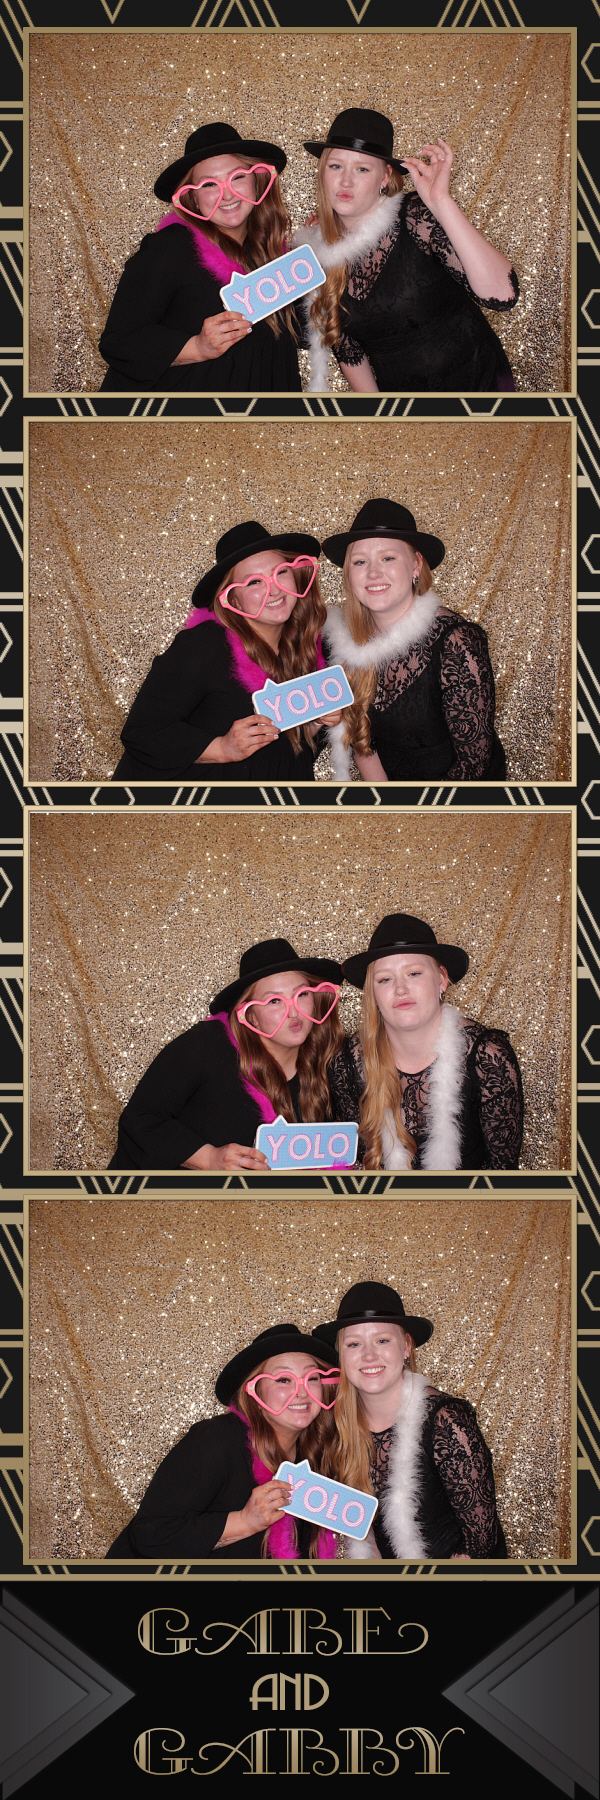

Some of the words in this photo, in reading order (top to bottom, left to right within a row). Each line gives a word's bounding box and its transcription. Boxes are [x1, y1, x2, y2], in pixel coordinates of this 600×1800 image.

[231, 258, 314, 315] YOLO
[263, 677, 343, 723] YOLO
[266, 1132, 350, 1162] YOLO
[286, 1473, 366, 1528] YOLO
